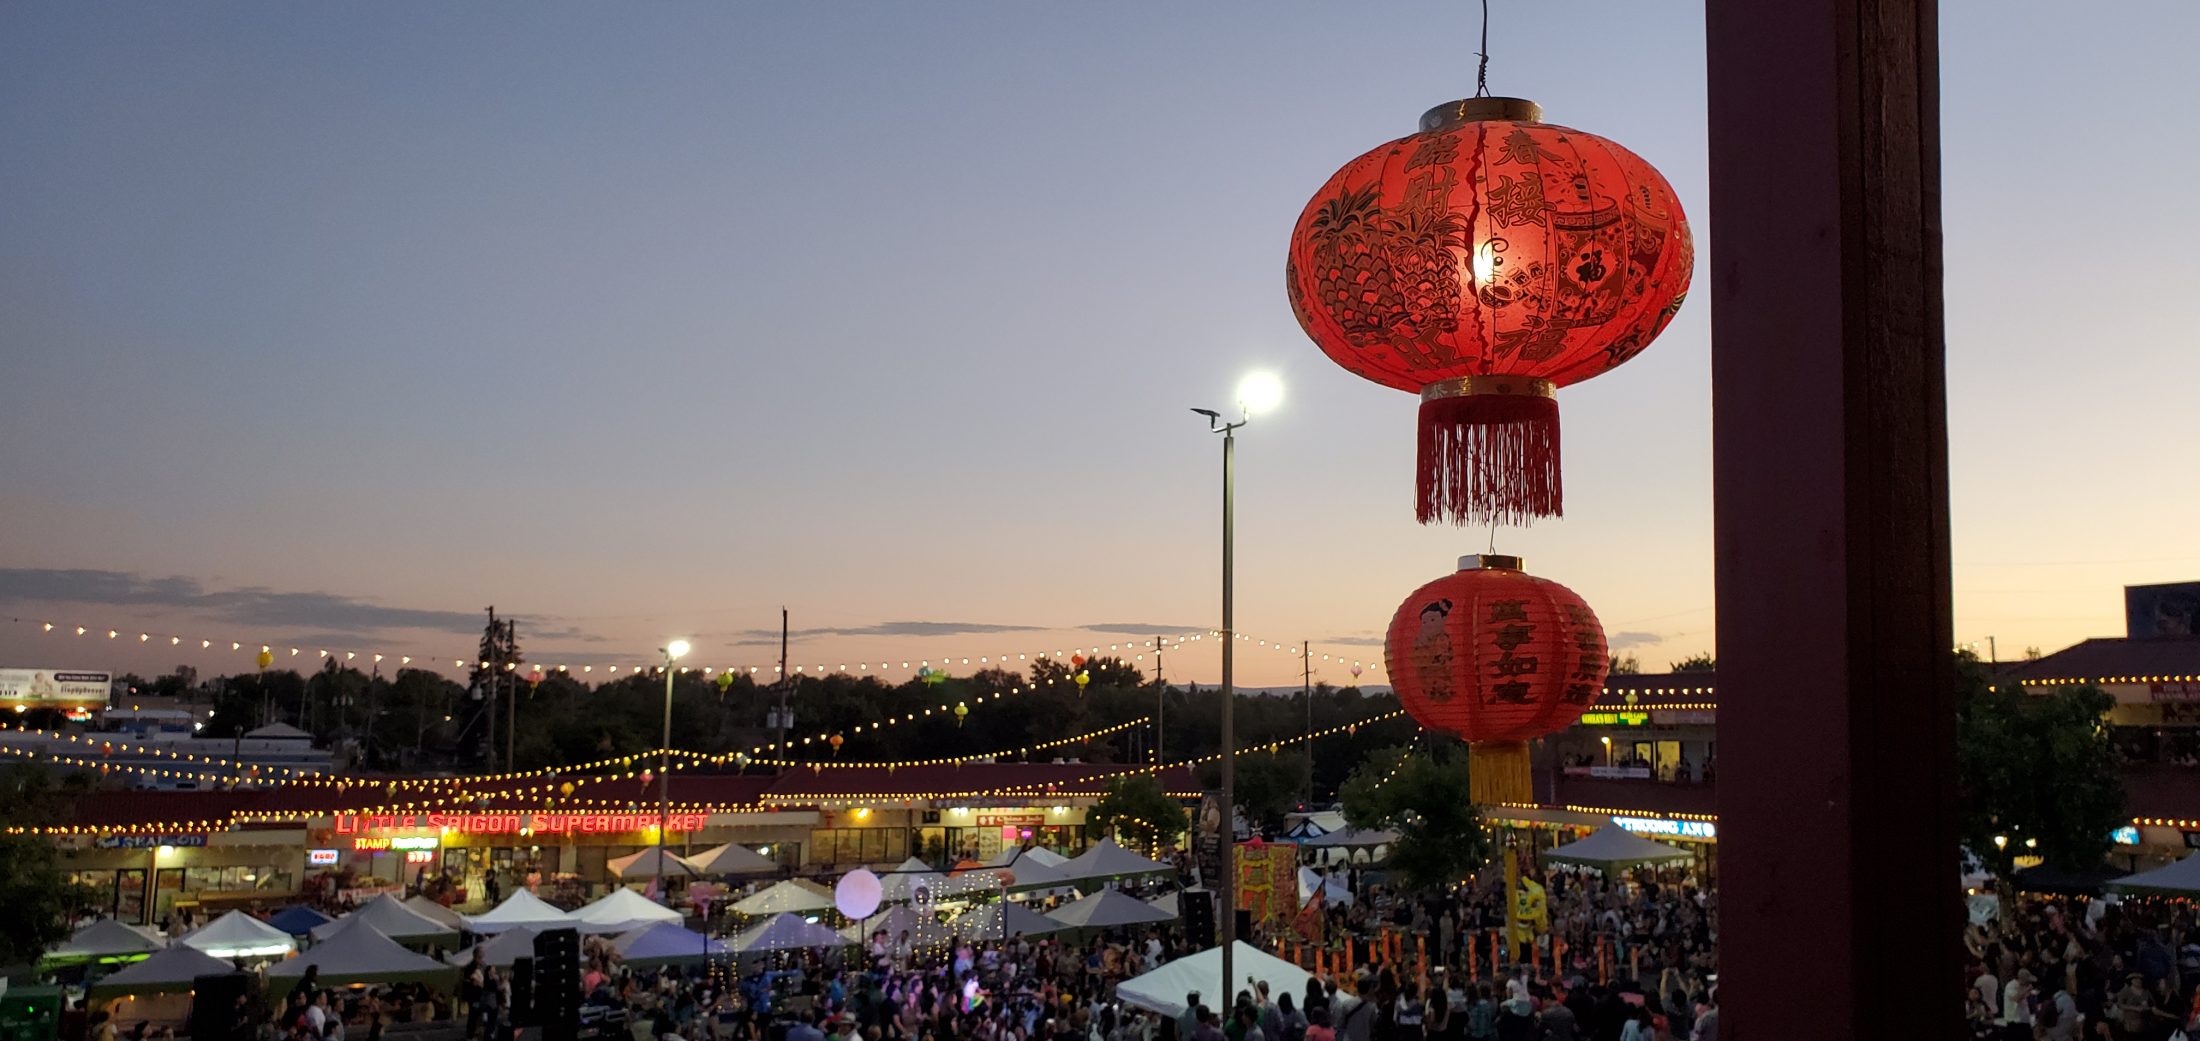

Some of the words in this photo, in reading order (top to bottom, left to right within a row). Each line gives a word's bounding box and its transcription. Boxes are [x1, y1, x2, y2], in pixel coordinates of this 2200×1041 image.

[427, 814, 521, 834] SAIGON
[530, 814, 709, 834] SUPERMARKET
[355, 838, 390, 850] STAMP
